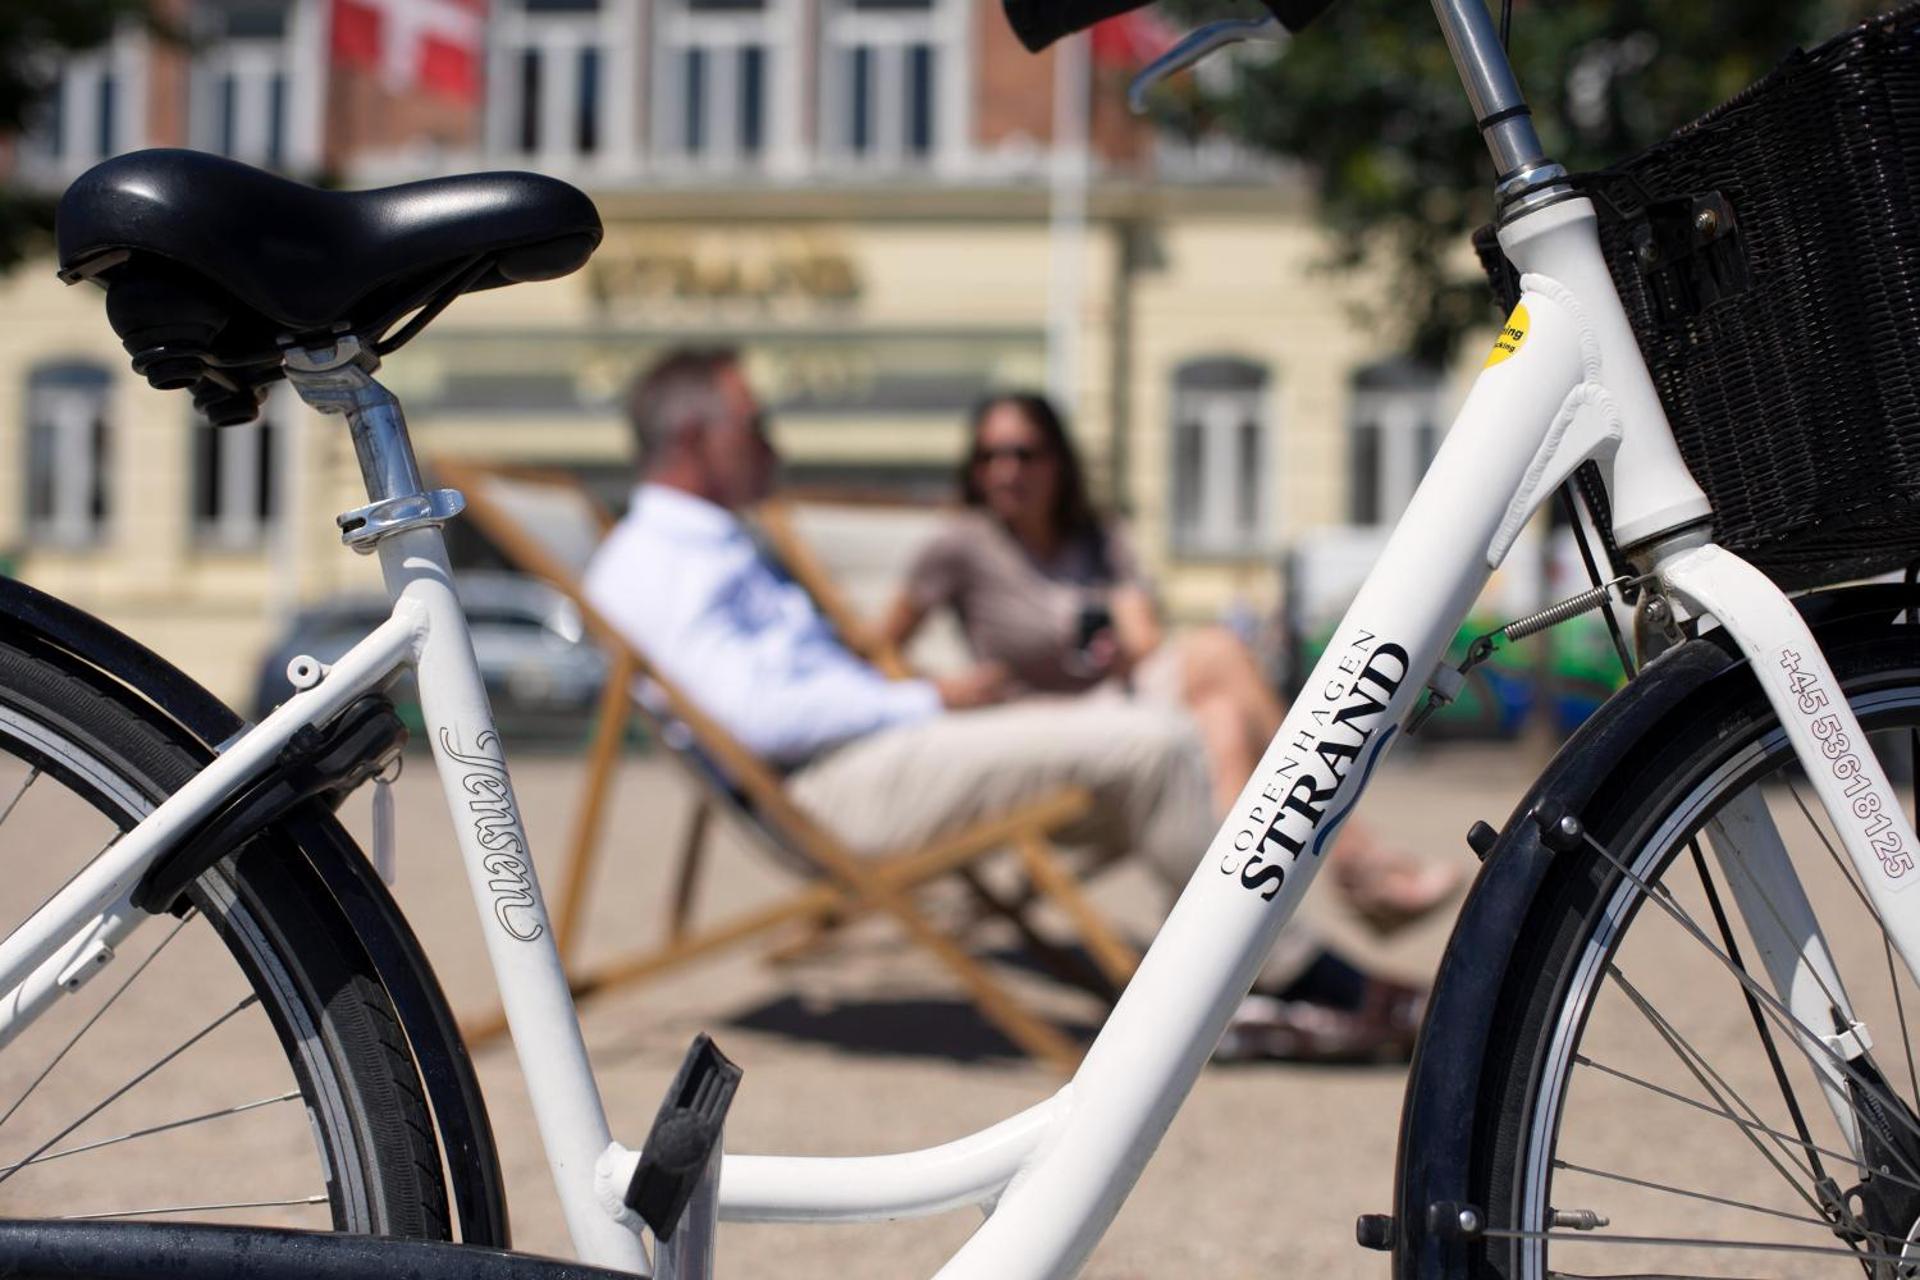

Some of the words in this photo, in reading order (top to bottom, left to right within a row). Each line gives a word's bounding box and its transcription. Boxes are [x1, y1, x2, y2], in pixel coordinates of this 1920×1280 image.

[439, 727, 543, 941] Jensen
[1219, 628, 1376, 876] COPENHAGEN
[1240, 642, 1410, 902] STRAND
[1779, 648, 1829, 715] +45
[1811, 713, 1914, 878] 53618125
